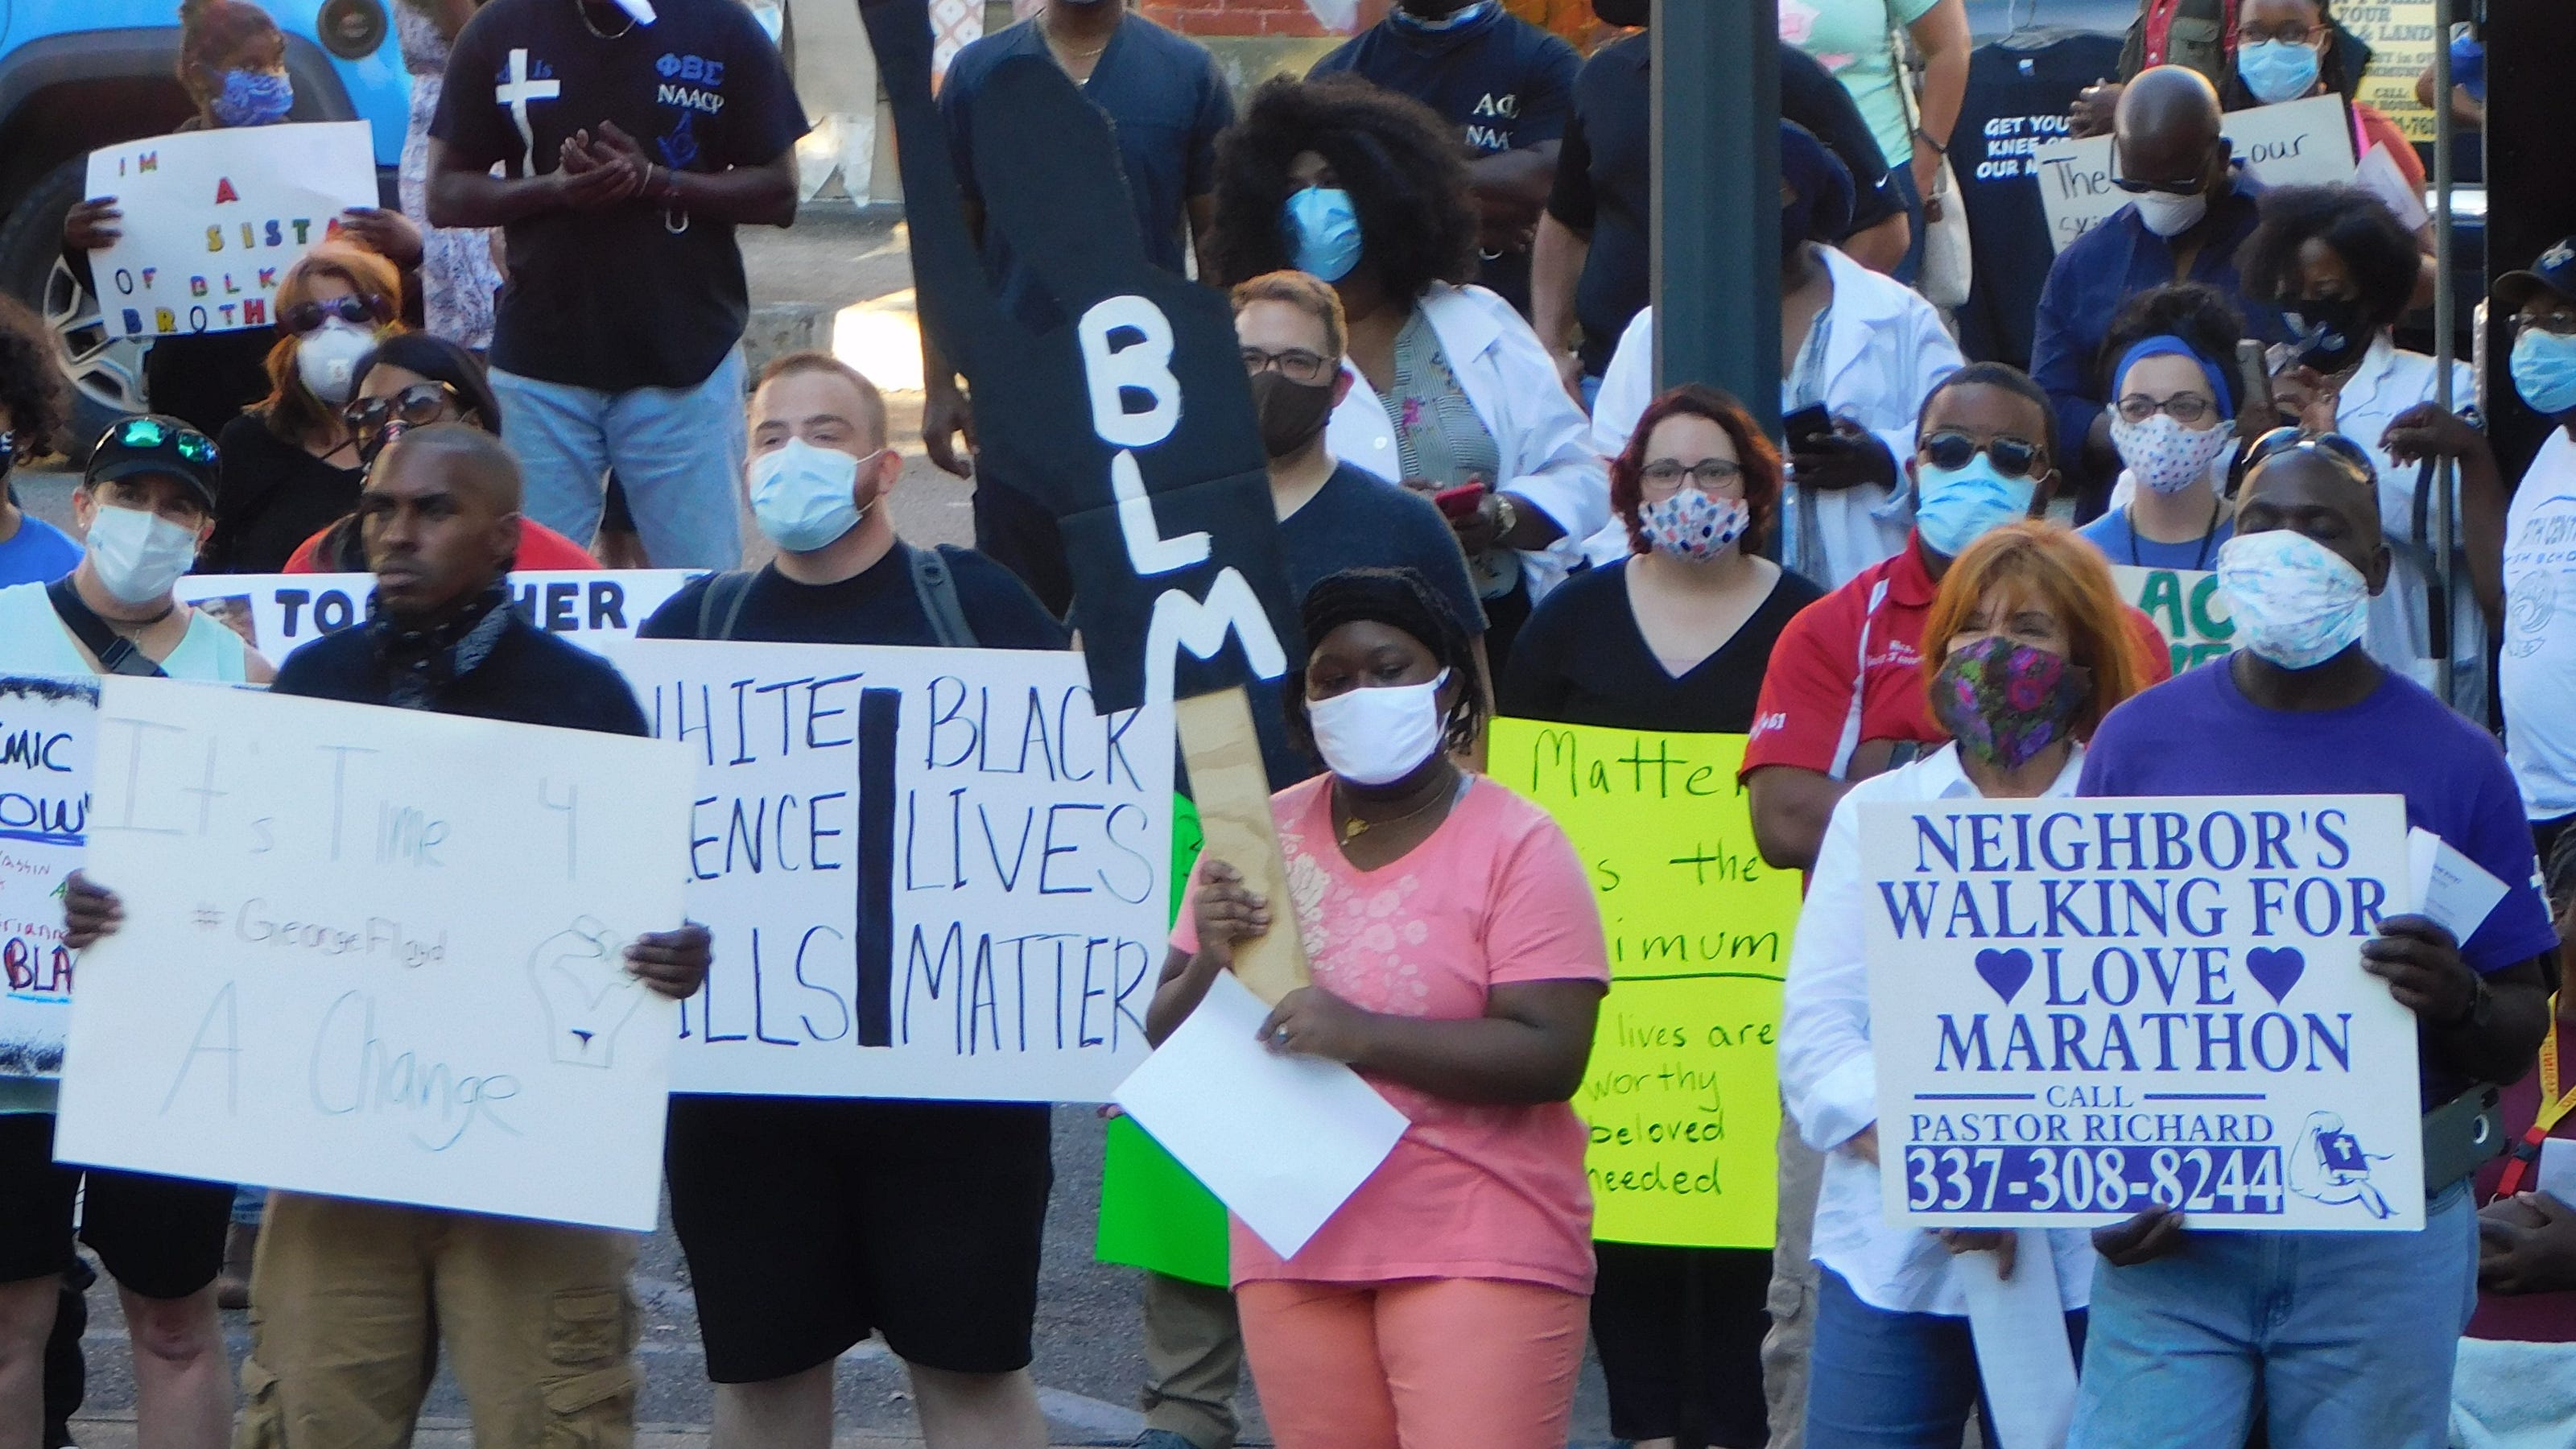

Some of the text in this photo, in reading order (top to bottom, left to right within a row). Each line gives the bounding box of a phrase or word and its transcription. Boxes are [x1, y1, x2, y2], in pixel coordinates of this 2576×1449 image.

[657, 83, 724, 114] NAACP
[1984, 117, 2025, 137] GET
[2252, 134, 2309, 163] our
[215, 176, 240, 204] A
[1975, 159, 2019, 180] OUR
[2042, 155, 2111, 200] The
[115, 266, 157, 295] OF
[1078, 295, 1287, 707] BLM
[0, 721, 73, 772] MIC
[538, 776, 579, 882] 4
[686, 791, 848, 883] ENCE
[906, 786, 1154, 905] LIVES
[1913, 808, 2352, 873] NEIGHBOR'S
[1669, 837, 1759, 886] the
[1877, 877, 2228, 939] WALKING
[2248, 877, 2389, 937] FOR
[902, 920, 1157, 1055] MATTER
[2042, 946, 2236, 1007] LOVE
[1616, 1012, 1775, 1047] lives are
[1934, 1012, 2354, 1073] MARATHON
[310, 989, 524, 1152] Change
[1584, 1059, 1720, 1113] worthy
[2046, 1084, 2135, 1109] CALL
[1588, 1108, 1725, 1145] beloved
[1910, 1113, 2275, 1142] PASTOR RICHARD
[1908, 1146, 2283, 1212] 337-308-8244
